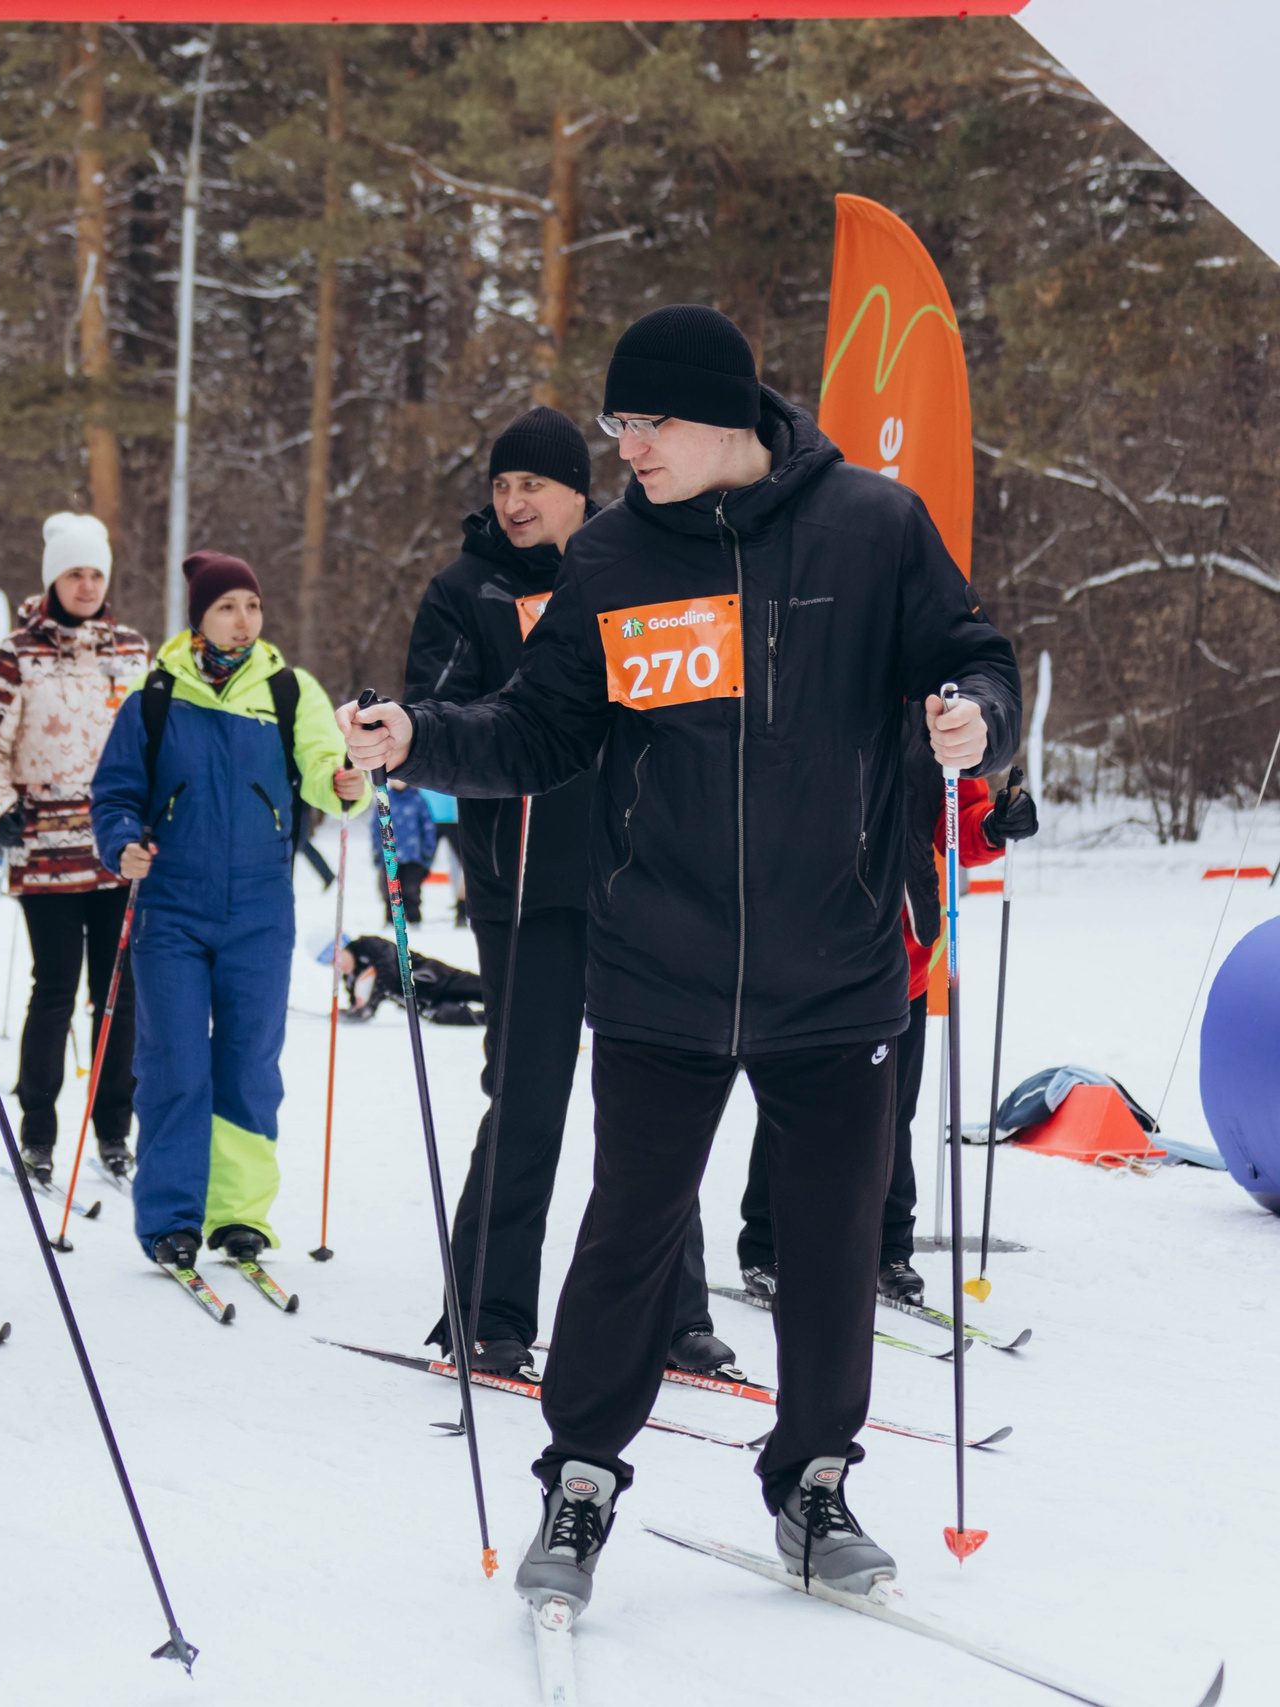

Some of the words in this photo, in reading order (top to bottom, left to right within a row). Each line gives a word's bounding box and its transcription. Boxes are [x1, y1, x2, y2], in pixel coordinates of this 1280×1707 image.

[799, 596, 835, 607] OUTVENTURE
[647, 609, 716, 631] Goodline
[622, 645, 721, 700] 270
[441, 1367, 529, 1396] MDSHUS
